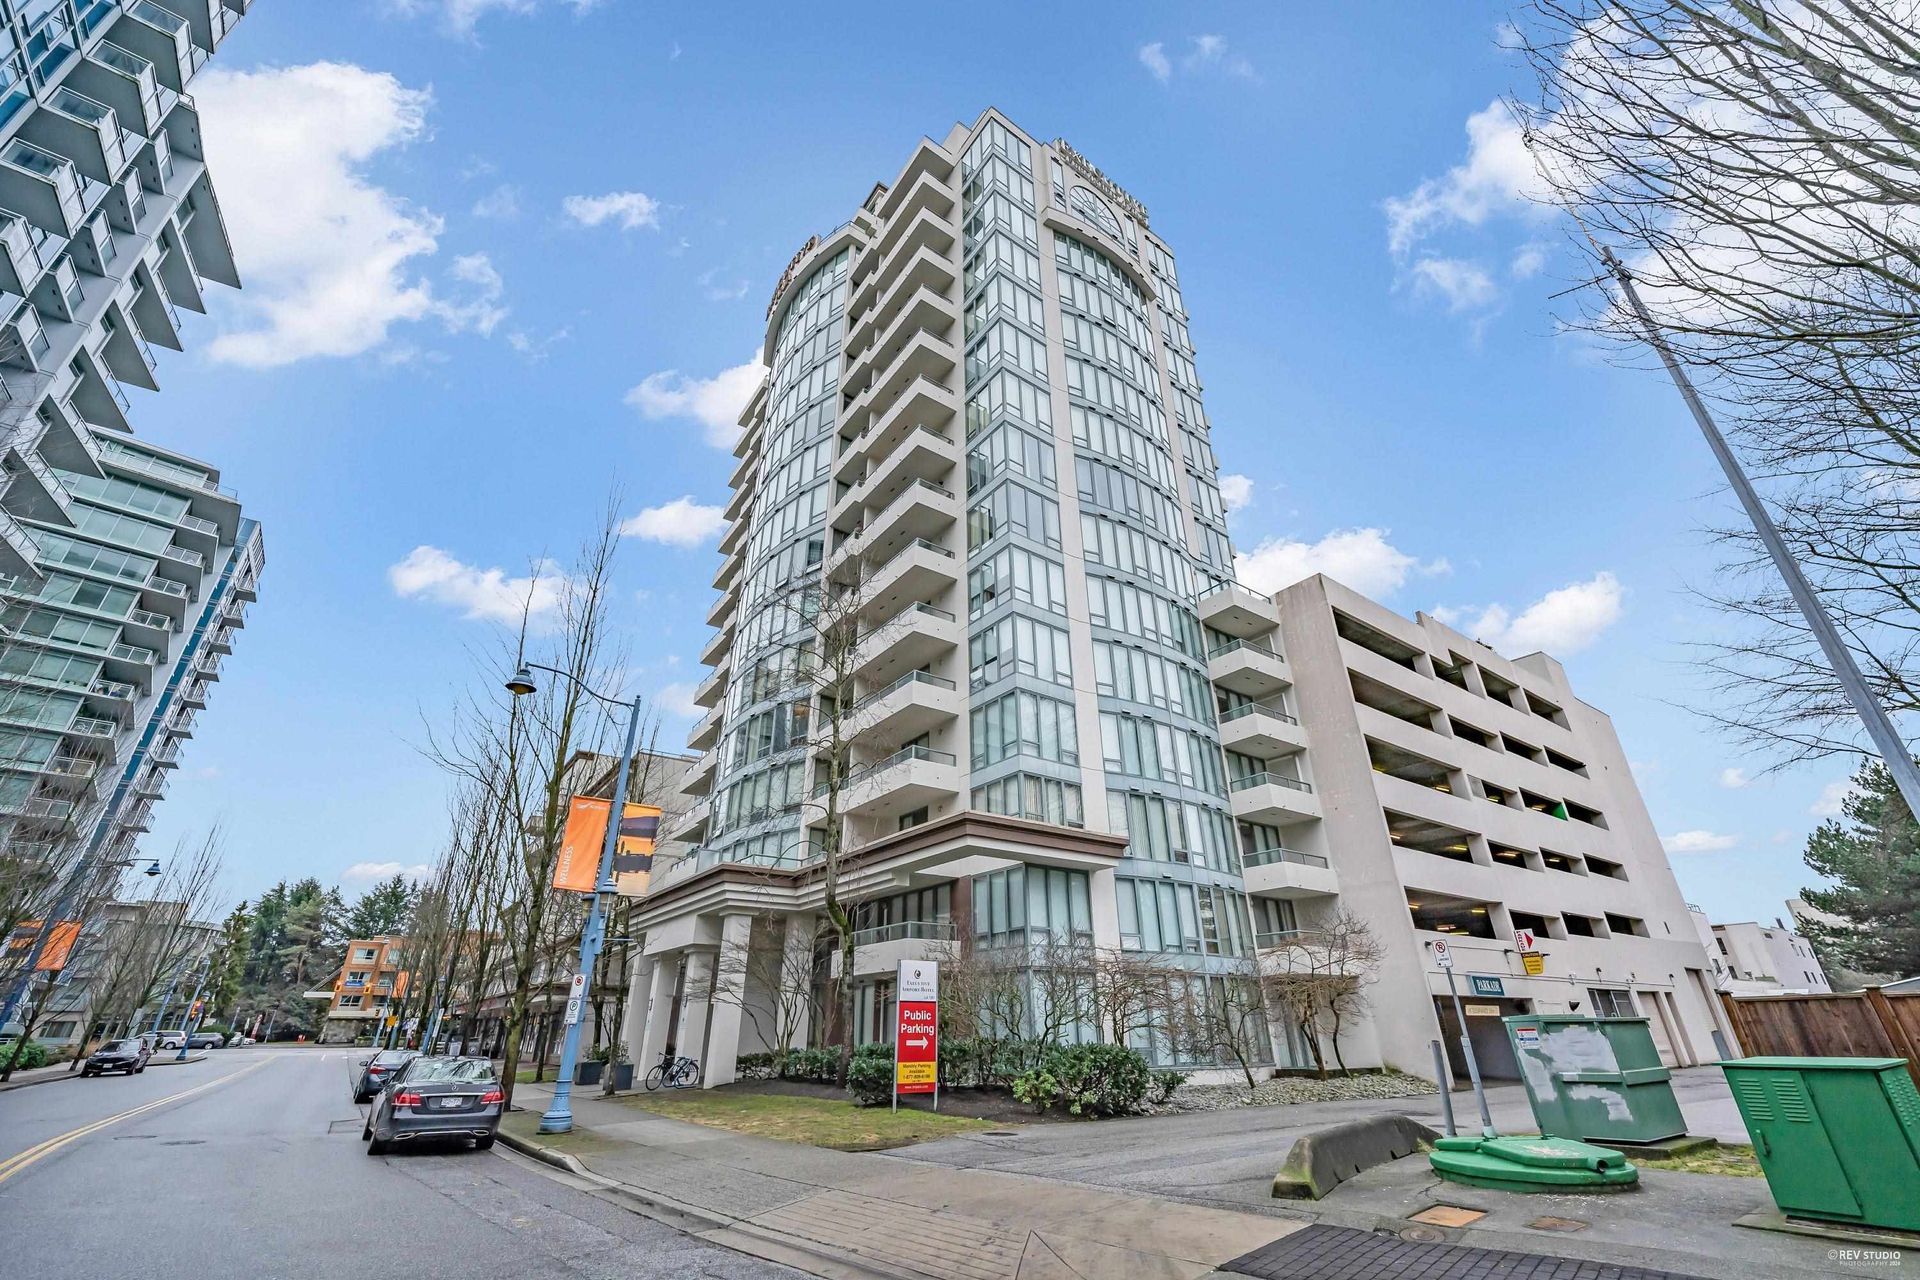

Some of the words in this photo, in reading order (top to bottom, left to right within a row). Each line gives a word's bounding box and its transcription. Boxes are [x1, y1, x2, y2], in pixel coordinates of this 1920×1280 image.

[559, 845, 574, 884] WELLNESS
[903, 1010, 932, 1020] Public
[900, 1023, 935, 1036] Parking
